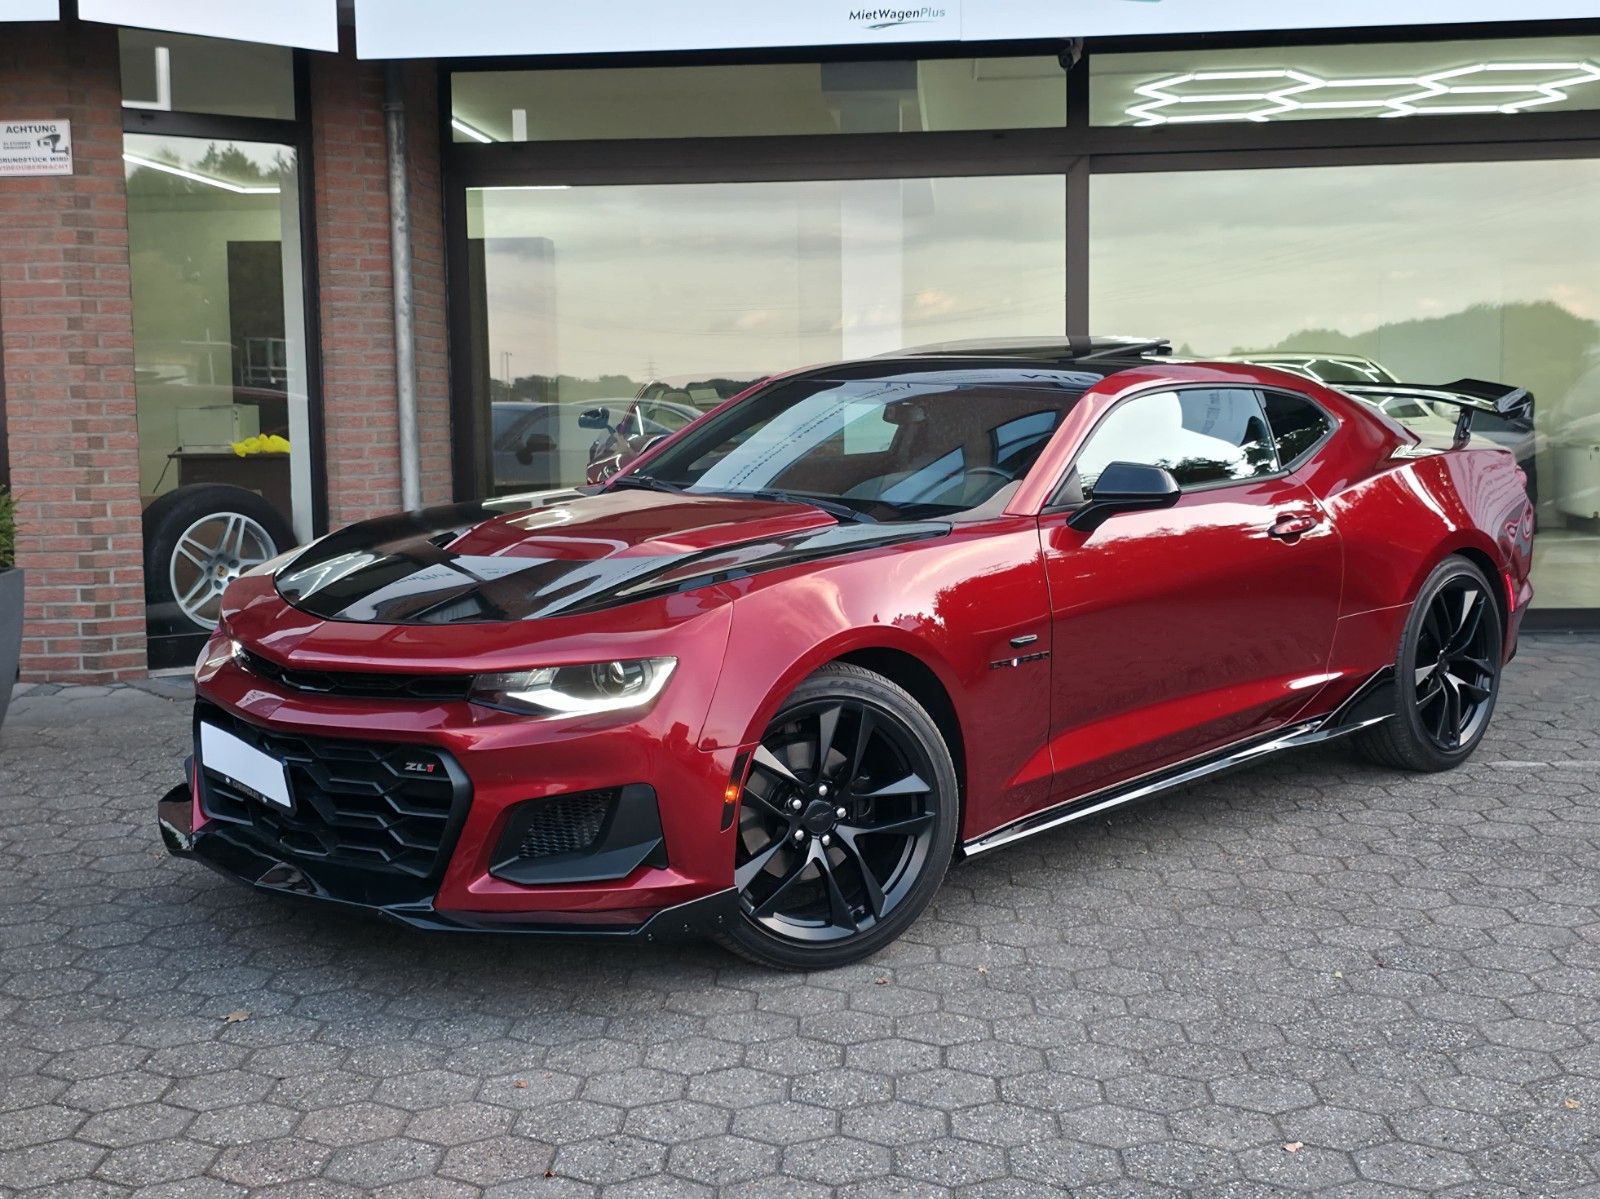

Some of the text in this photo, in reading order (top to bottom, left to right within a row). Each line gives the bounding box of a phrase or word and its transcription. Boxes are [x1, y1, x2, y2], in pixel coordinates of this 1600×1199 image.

[849, 7, 946, 22] MietWagenPlus
[6, 125, 57, 133] ACHTUNG
[404, 761, 436, 773] ZL1
